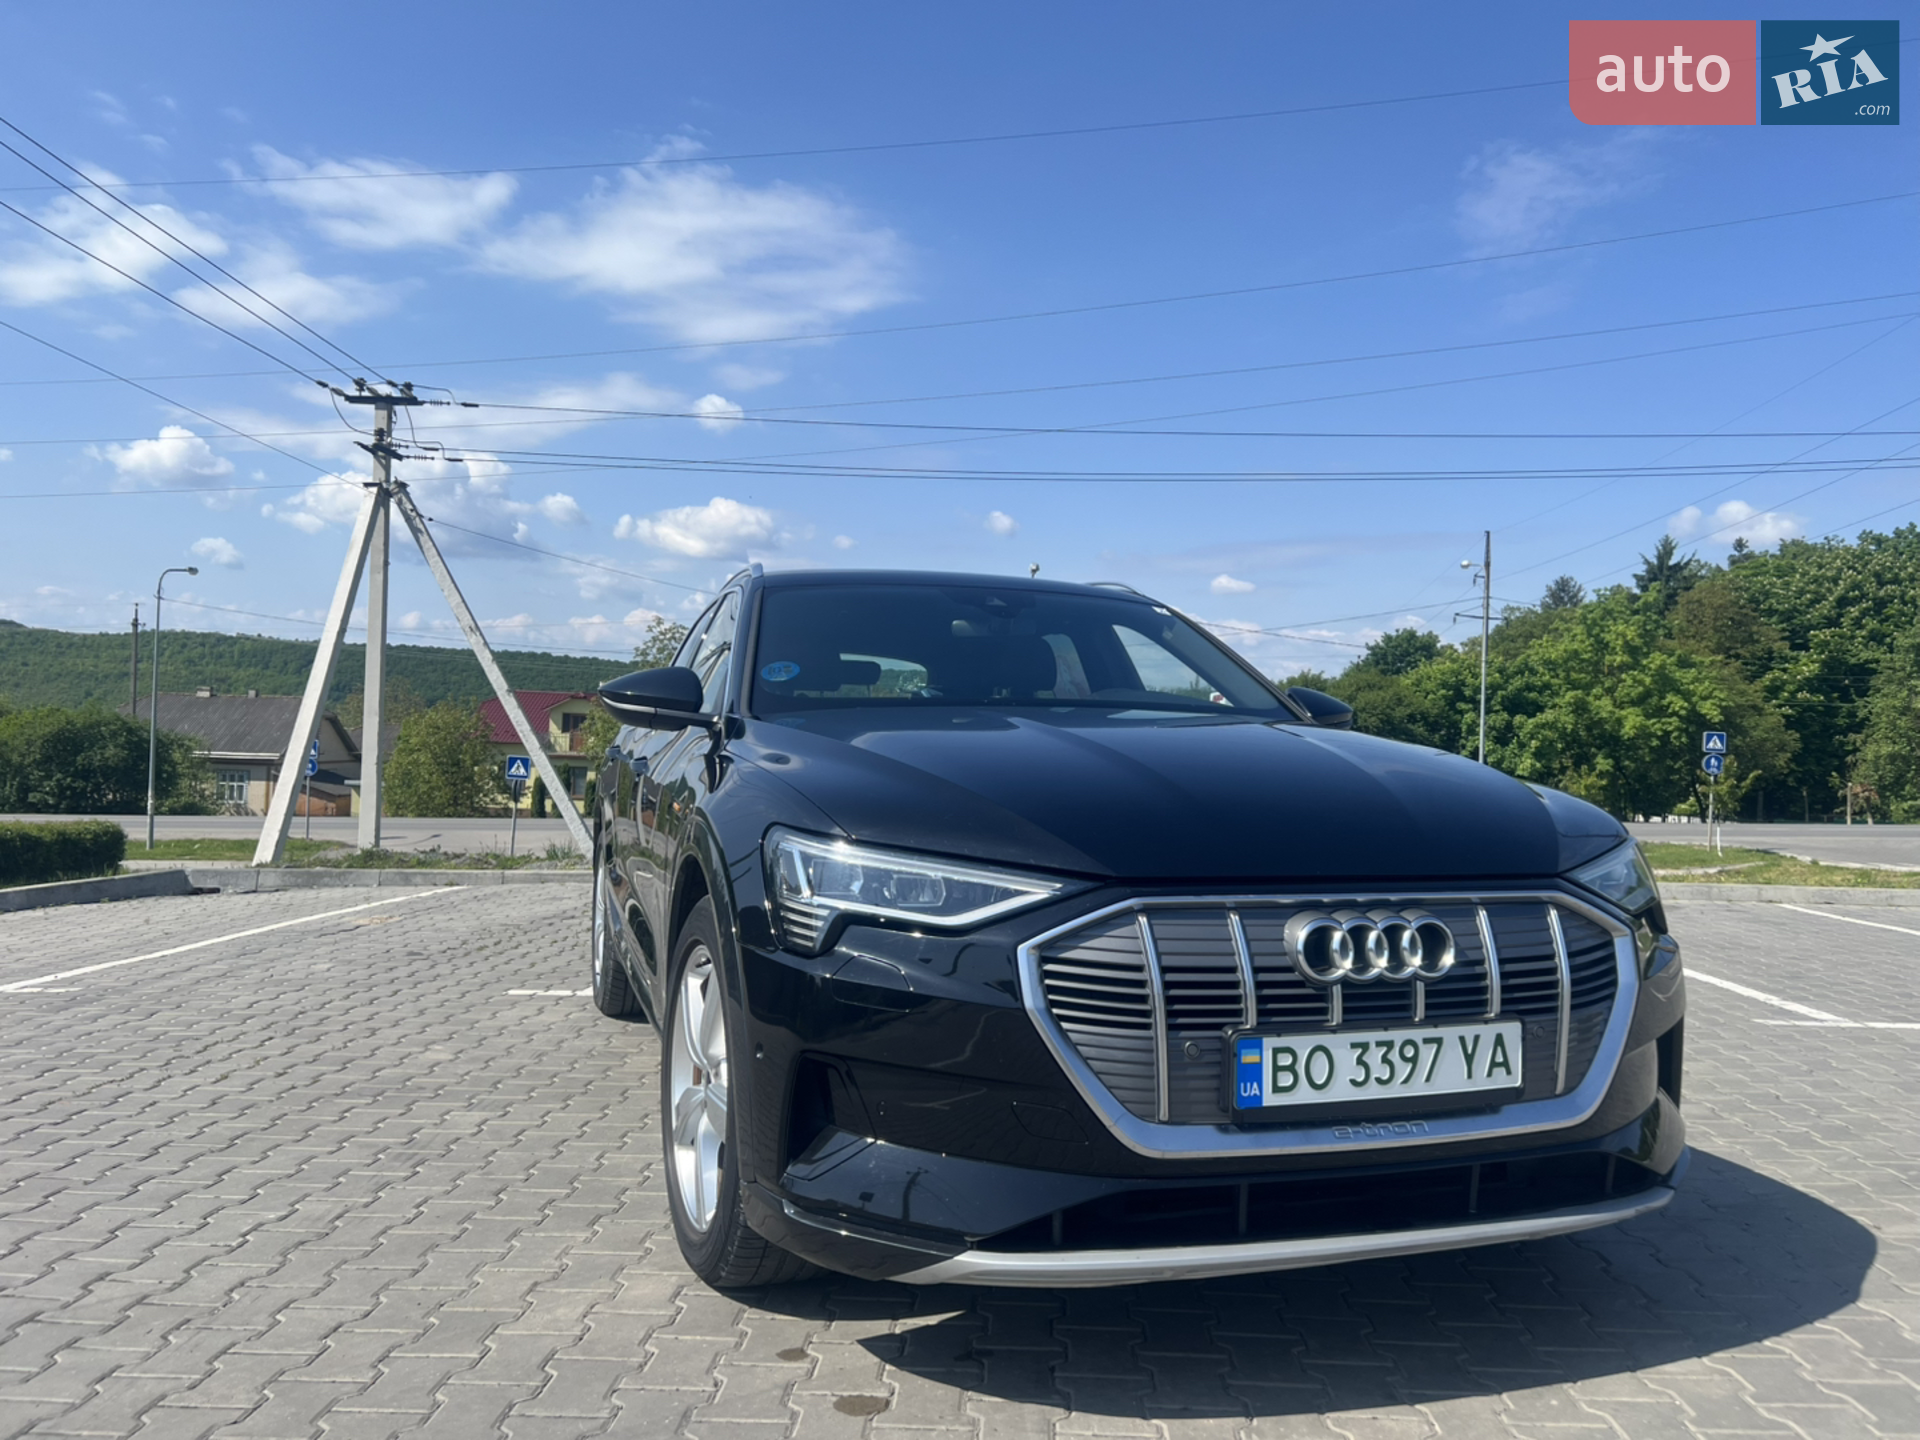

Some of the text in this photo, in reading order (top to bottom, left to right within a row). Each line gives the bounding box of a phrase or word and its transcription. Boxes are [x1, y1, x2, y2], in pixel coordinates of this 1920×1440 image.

[1271, 1032, 1512, 1094] BO 3397 YA
[1240, 1081, 1261, 1097] UA
[1331, 1120, 1429, 1140] e-tron
